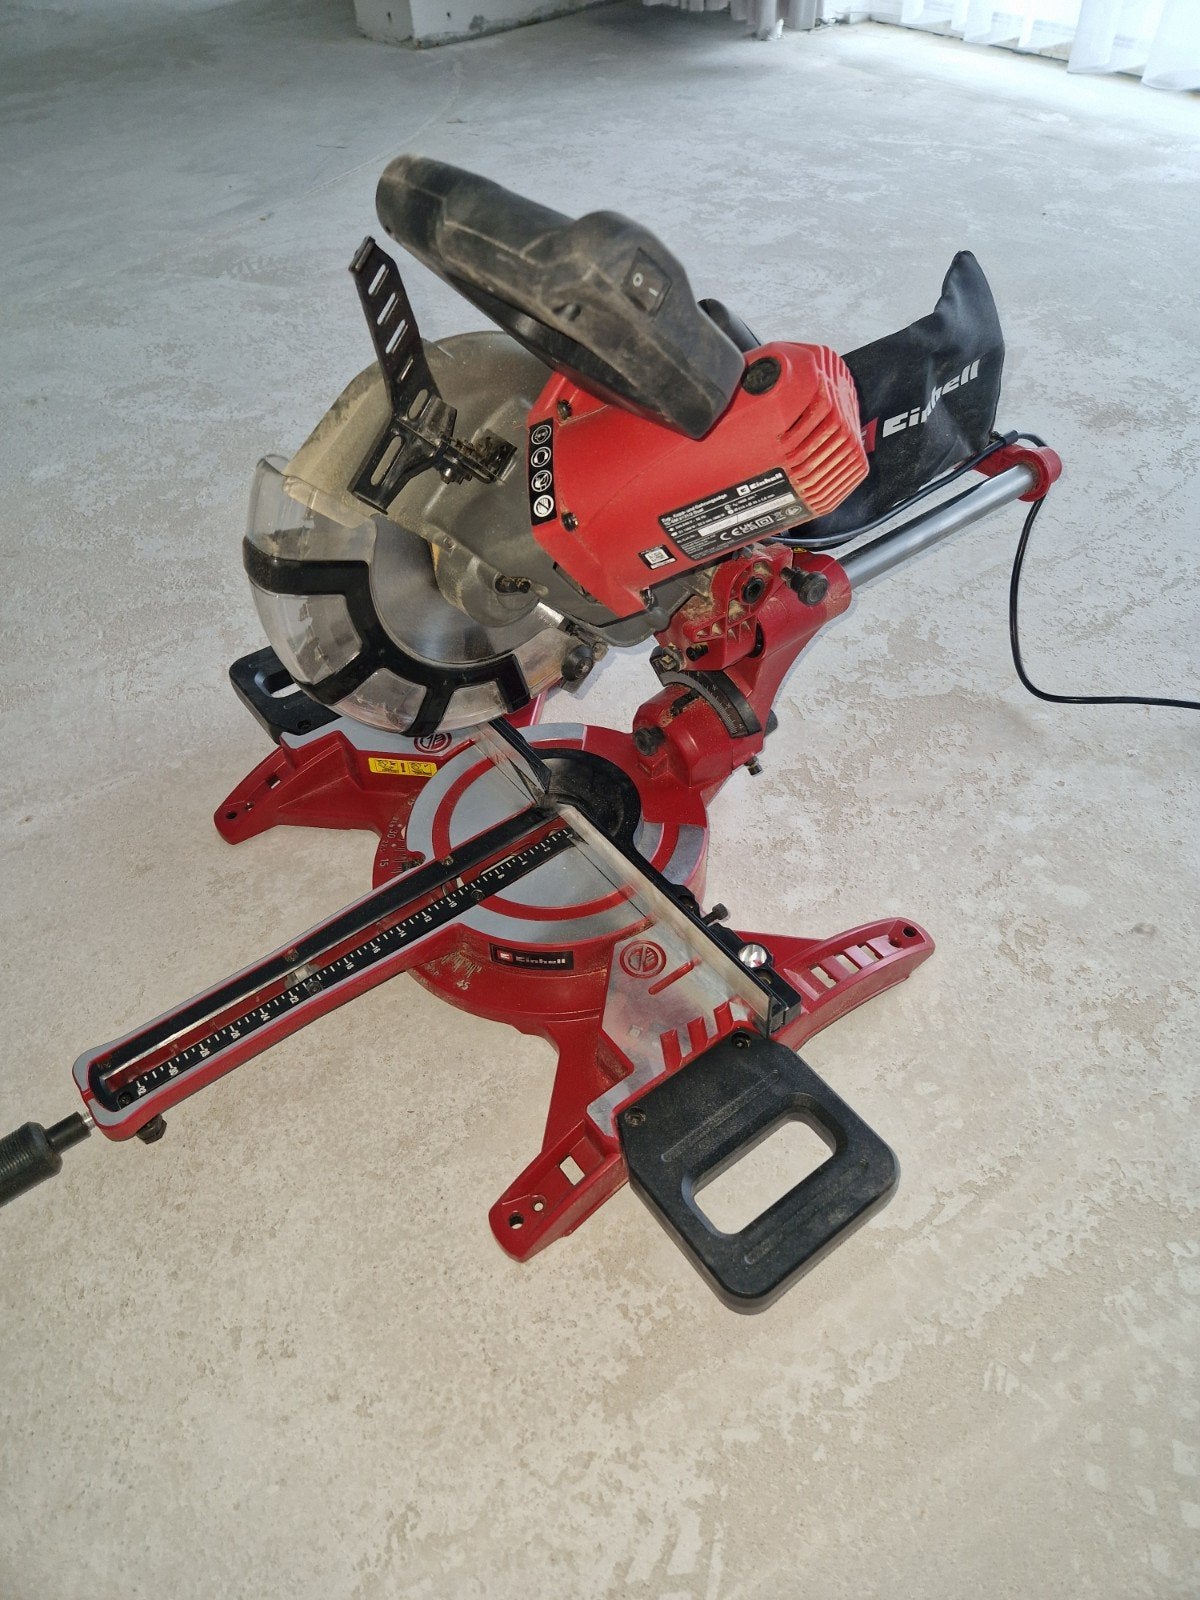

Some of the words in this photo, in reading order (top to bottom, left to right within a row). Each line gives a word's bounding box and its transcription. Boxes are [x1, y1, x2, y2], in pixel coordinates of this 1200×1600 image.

[882, 359, 981, 438] Einhell
[750, 472, 783, 489] Einhell
[379, 858, 389, 867] 15
[448, 901, 458, 909] 10
[423, 915, 433, 923] 12
[398, 930, 407, 938] 14
[372, 945, 381, 953] 16
[515, 956, 566, 964] Einhell
[345, 962, 355, 970] 18
[456, 979, 470, 991] 45
[290, 995, 300, 1004] 22
[260, 1012, 271, 1021] 24
[230, 1030, 241, 1039] 26
[168, 1066, 179, 1076] 30
[137, 1085, 148, 1096] 32
